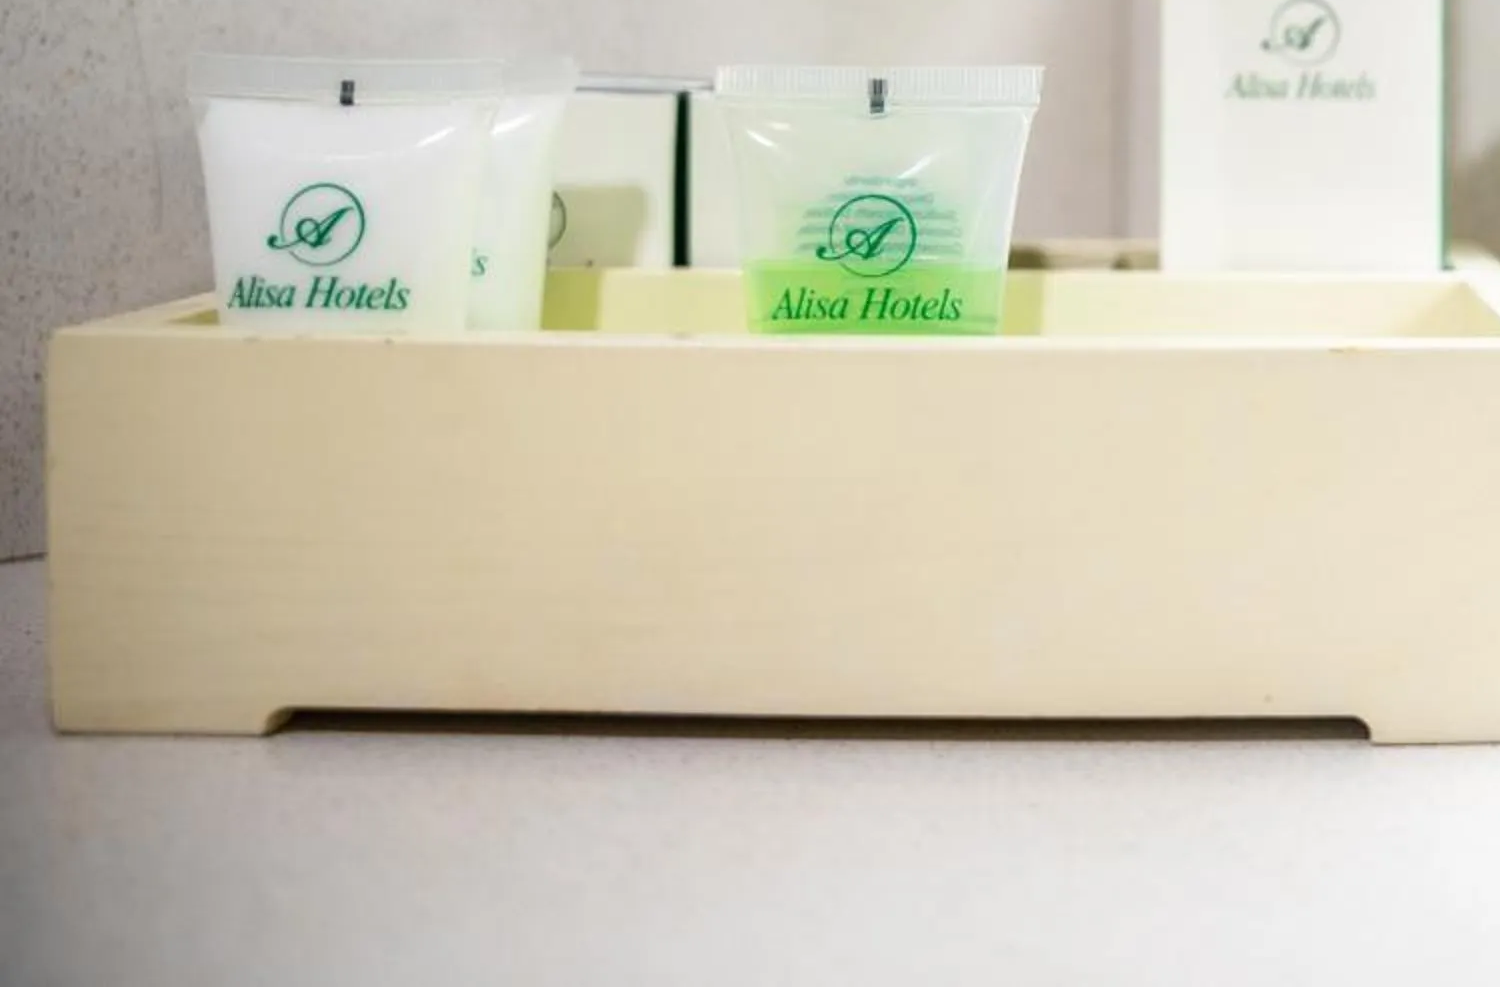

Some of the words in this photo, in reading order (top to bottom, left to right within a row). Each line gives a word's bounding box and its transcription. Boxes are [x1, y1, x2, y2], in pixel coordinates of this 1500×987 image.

[228, 276, 296, 310] Alisa
[306, 276, 411, 311] Hotels
[771, 287, 850, 321] Alisa
[860, 287, 963, 321] Hotels
